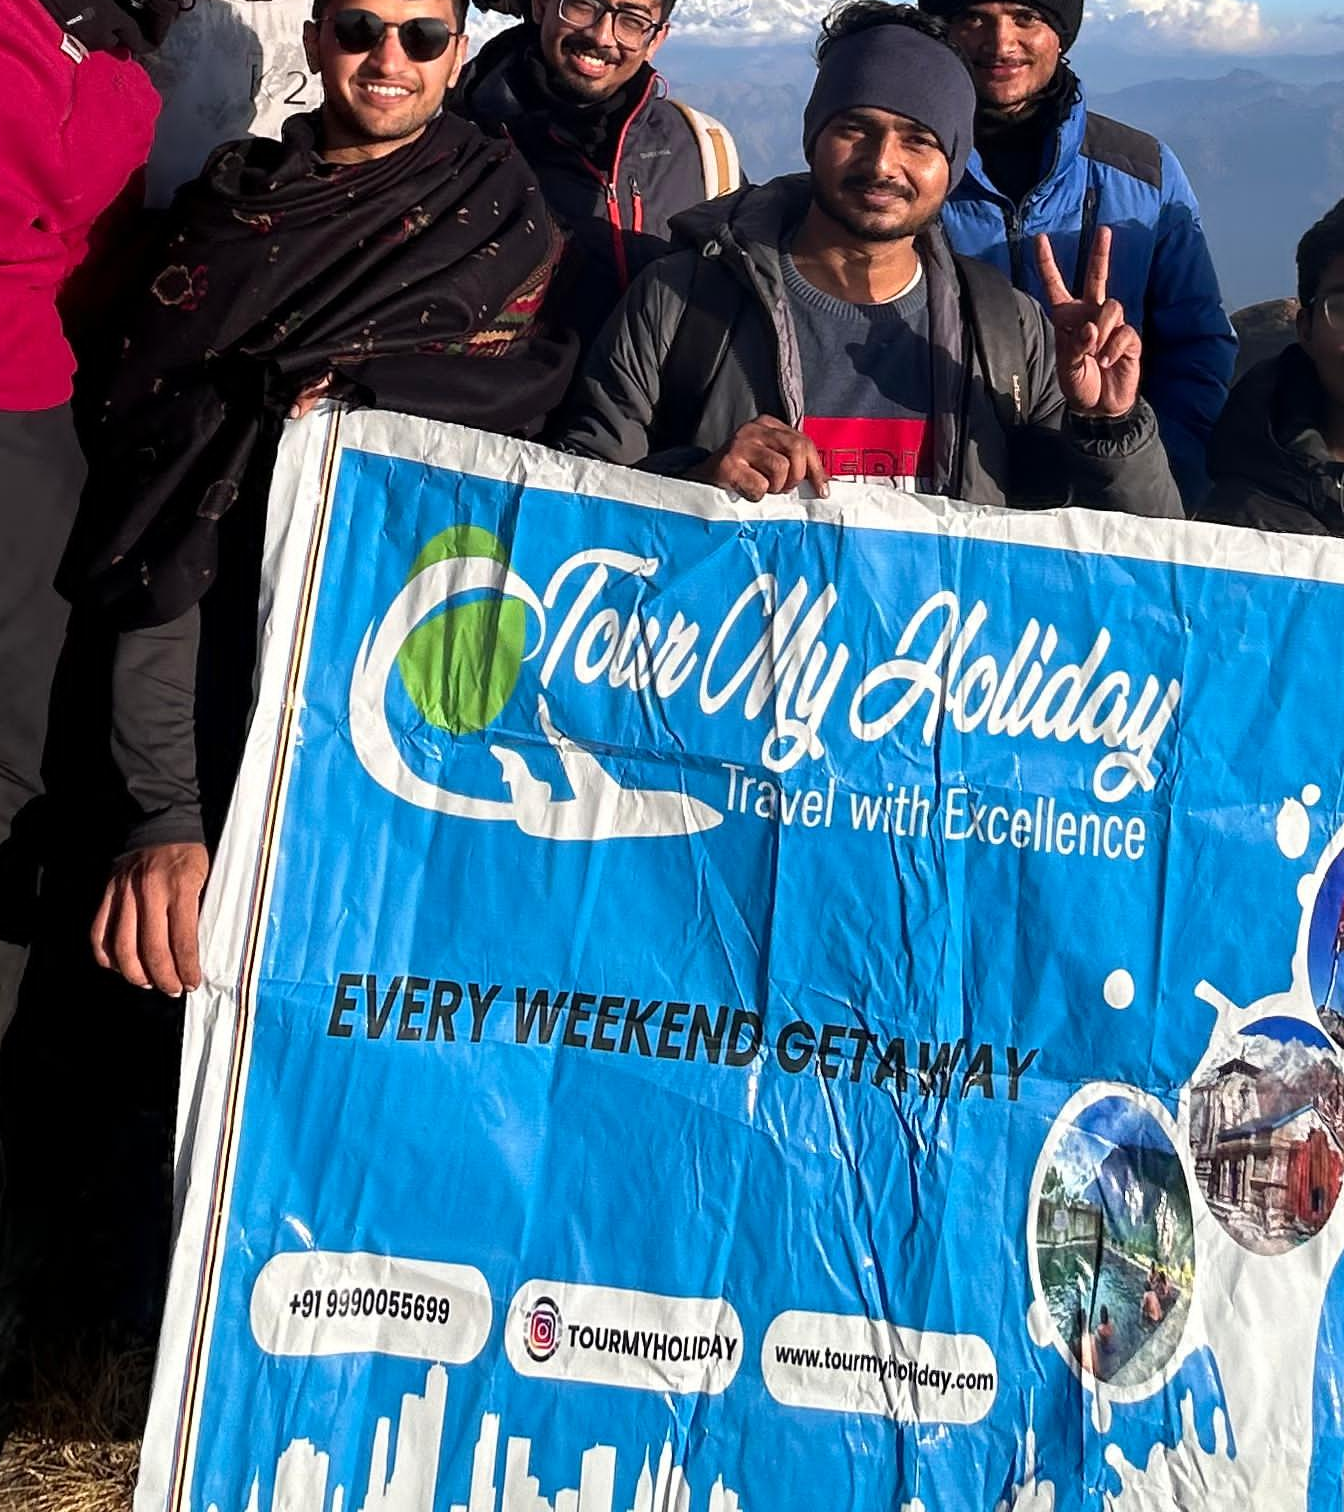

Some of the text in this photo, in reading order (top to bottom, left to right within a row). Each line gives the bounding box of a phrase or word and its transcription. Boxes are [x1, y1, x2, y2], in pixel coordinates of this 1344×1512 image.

[540, 549, 1181, 803] Tour My Holiday
[721, 763, 1147, 861] Travel with Excellence
[327, 973, 1040, 1101] EVERY WEEKEND GETAWAY
[289, 1287, 450, 1325] +91 9990055699
[567, 1324, 738, 1362] TOURMYHOLIDAY
[775, 1345, 994, 1395] www.tourmyholiday.com
